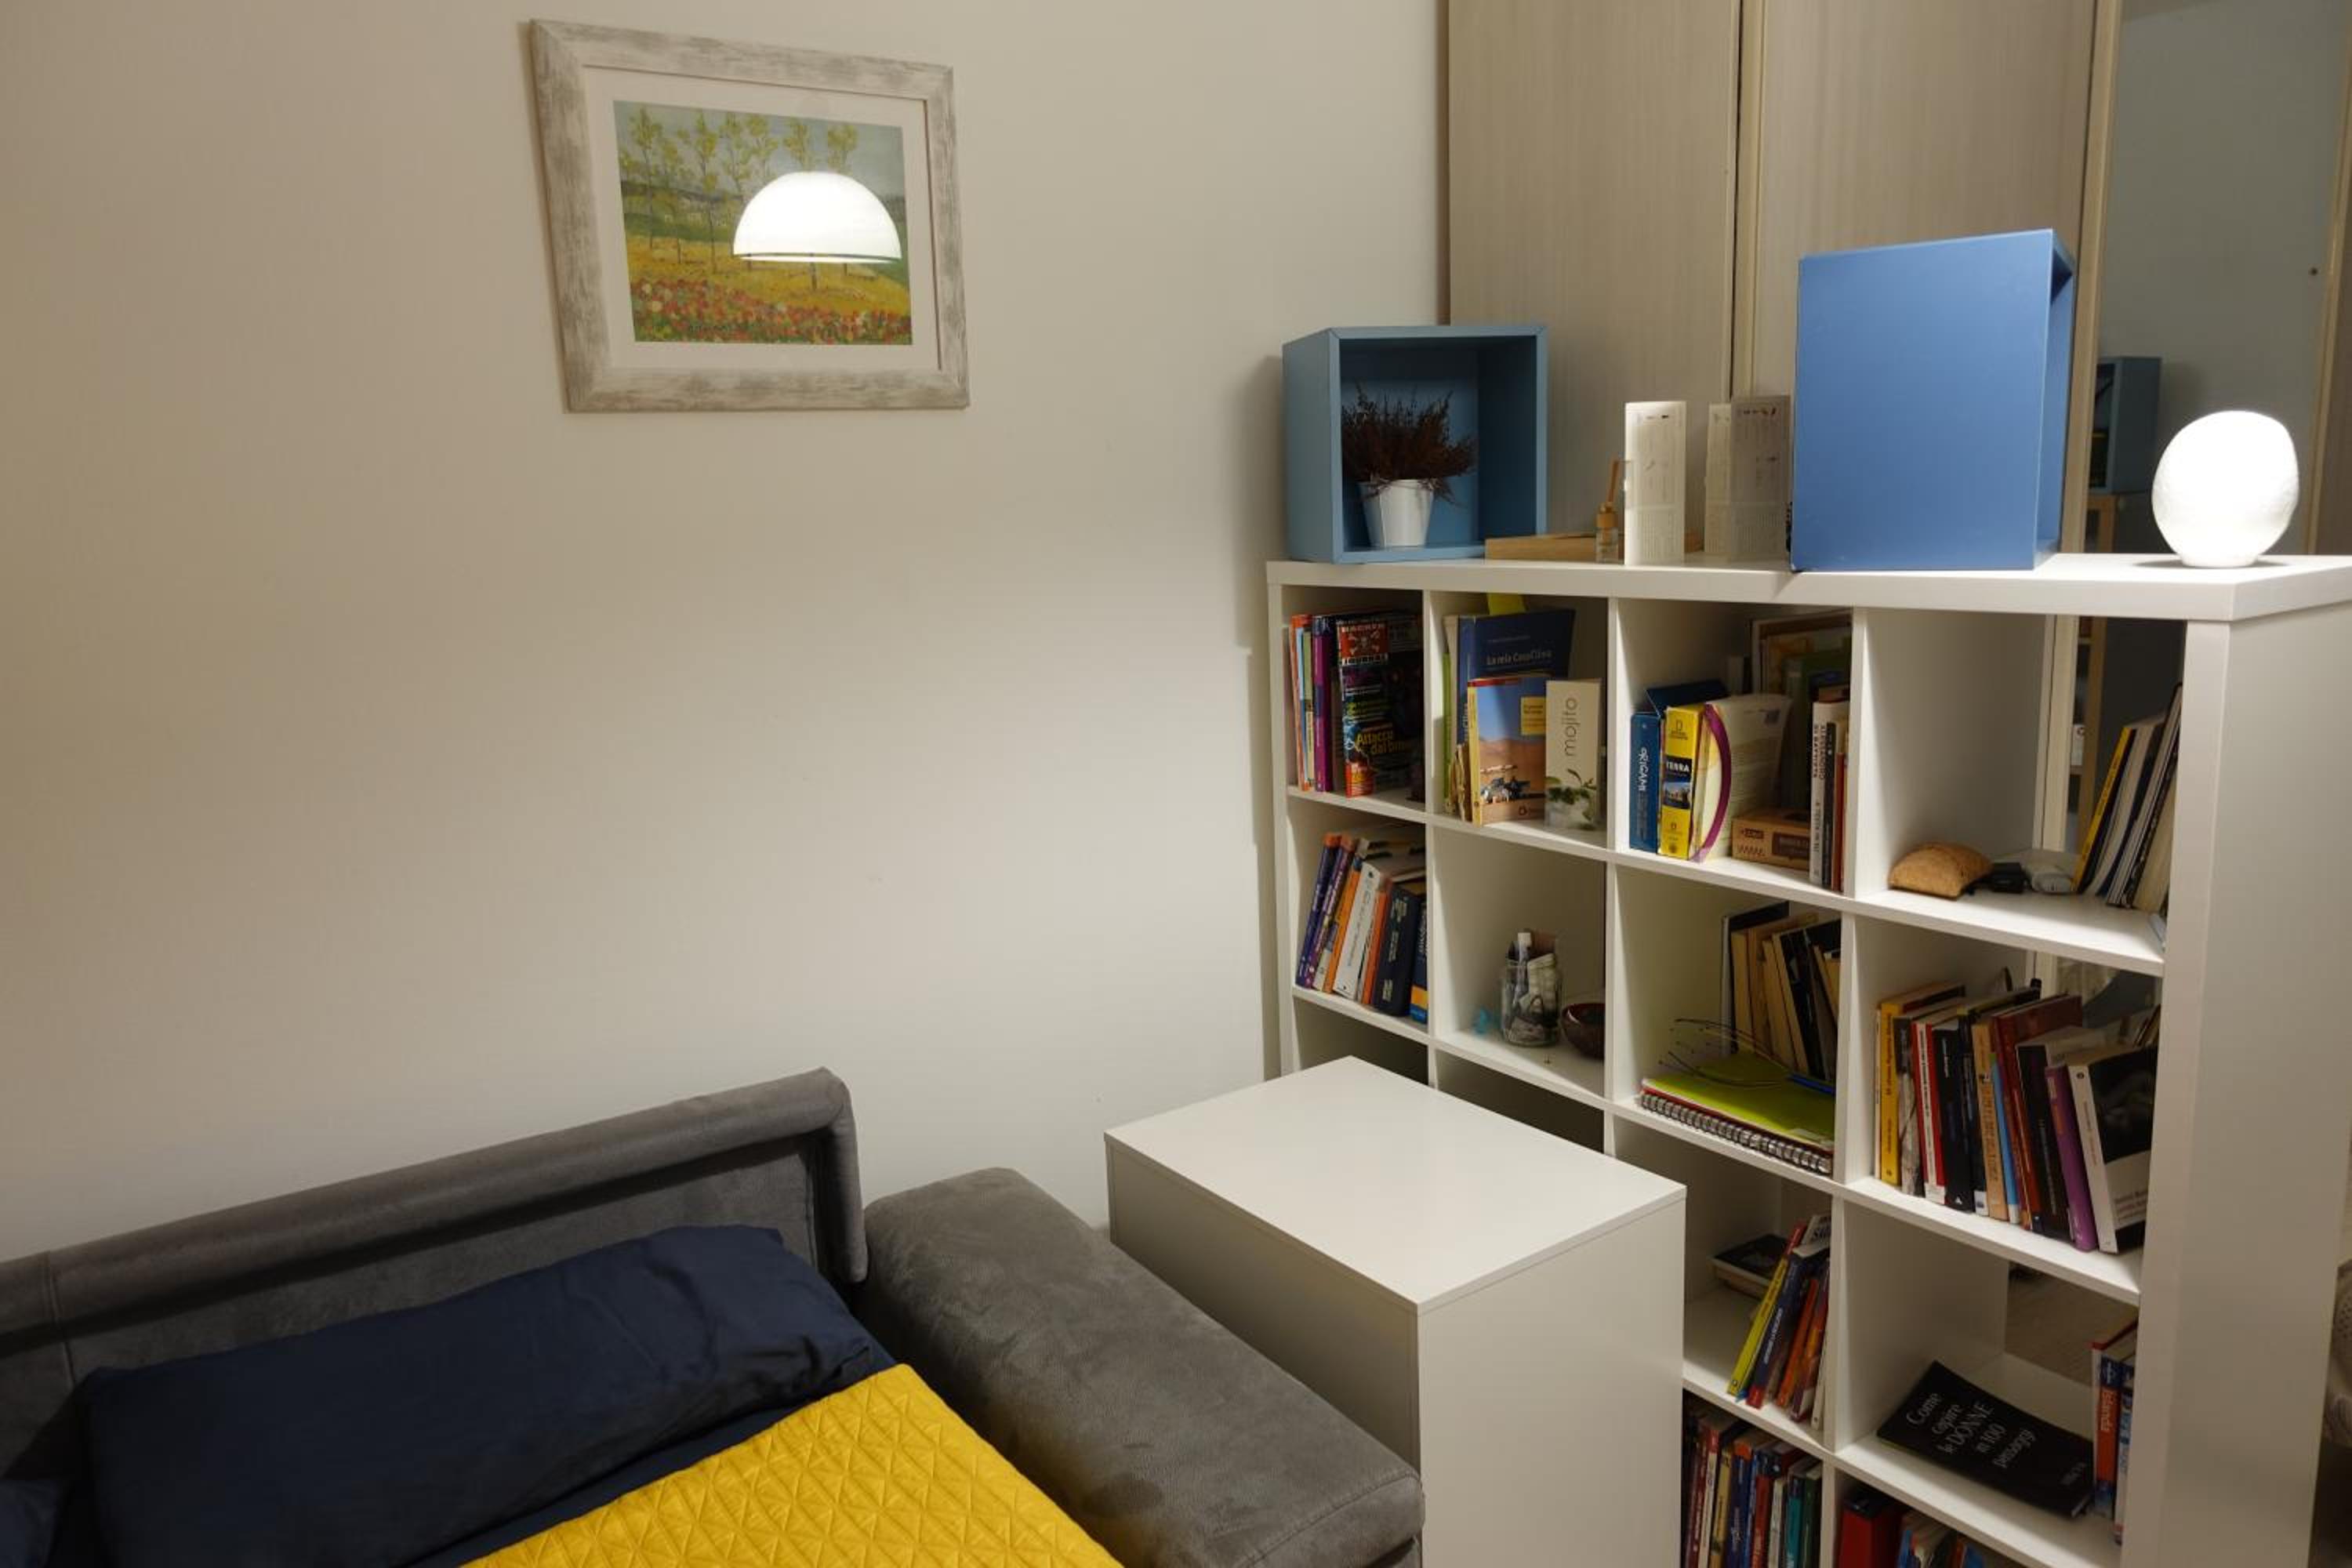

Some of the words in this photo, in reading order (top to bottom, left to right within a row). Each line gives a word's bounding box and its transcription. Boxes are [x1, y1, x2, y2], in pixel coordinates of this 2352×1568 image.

[1564, 697, 1581, 757] mojito
[1665, 760, 1690, 774] TERRA
[1907, 1392, 1942, 1425] Come
[1945, 1400, 1994, 1447] DONNE
[2100, 1390, 2115, 1433] Islanda
